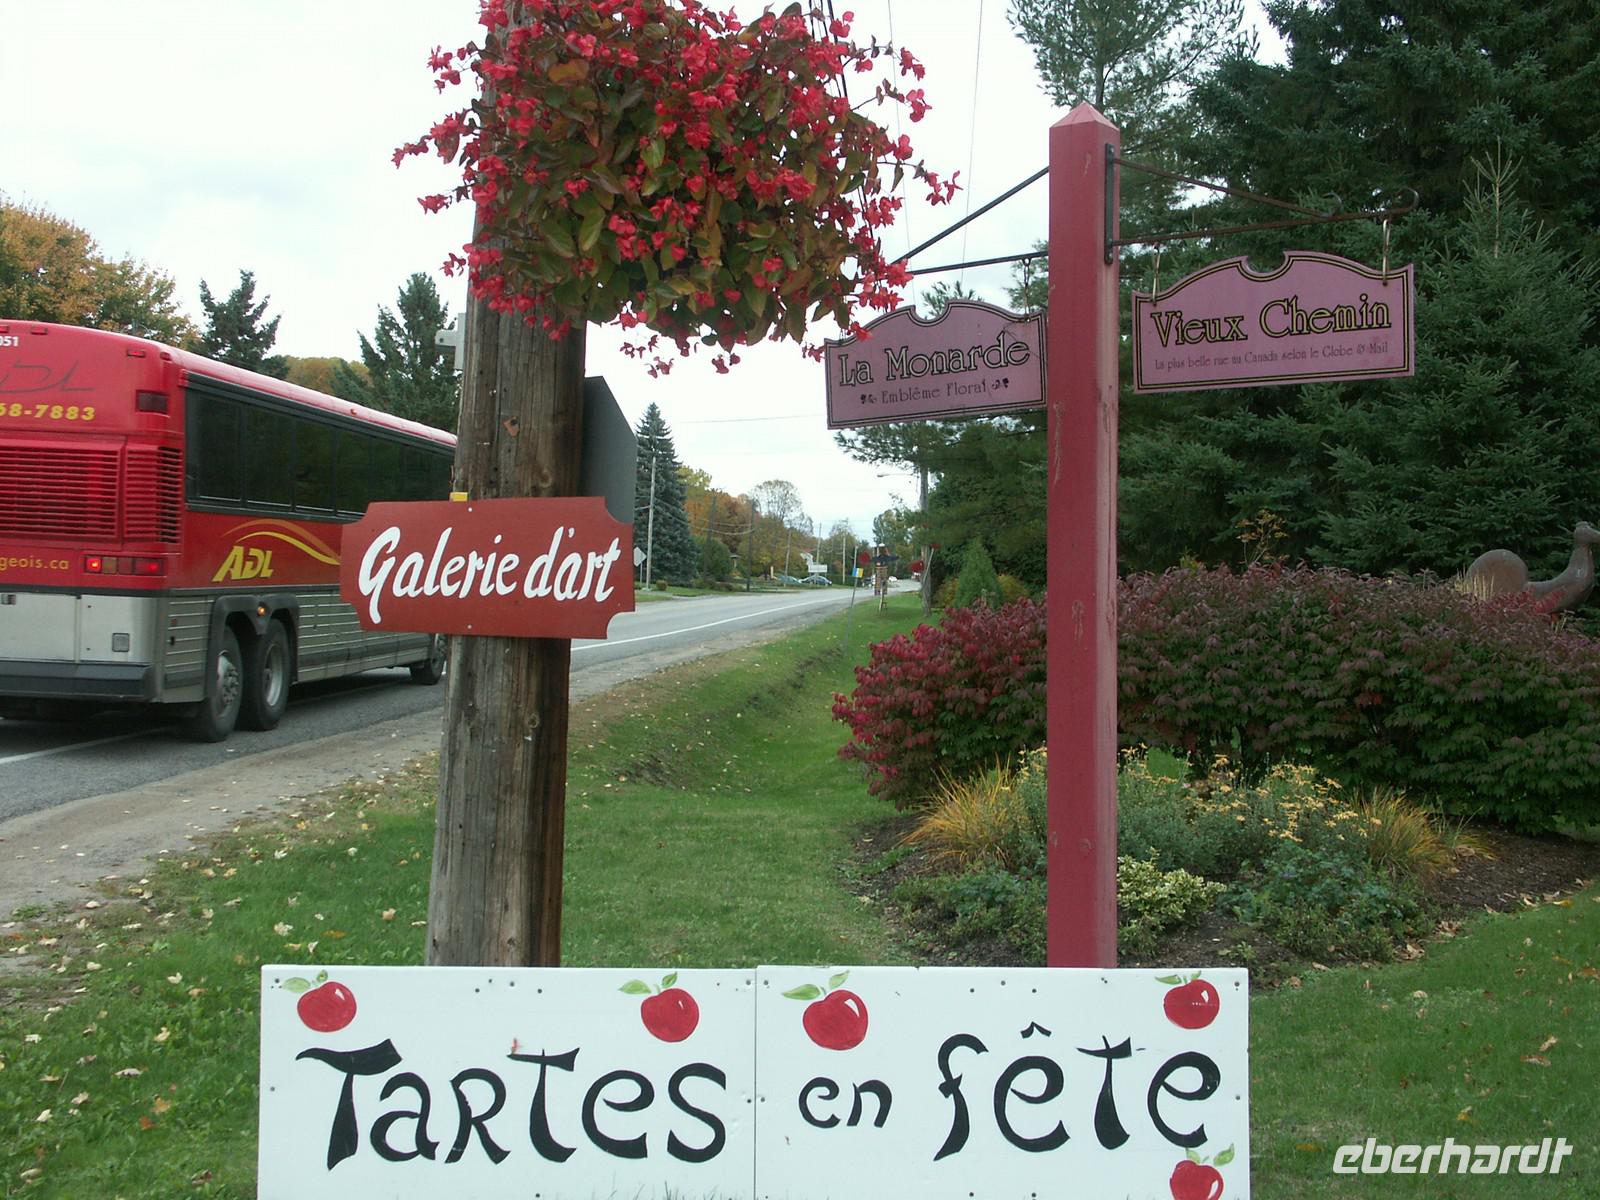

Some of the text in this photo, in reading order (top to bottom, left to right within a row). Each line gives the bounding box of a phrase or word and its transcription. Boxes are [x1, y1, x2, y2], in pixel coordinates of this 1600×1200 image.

[1151, 293, 1391, 347] Vieux Chemin
[838, 330, 1030, 387] La Monarde
[1168, 357, 1185, 372] plus
[1188, 355, 1211, 368] belle
[1214, 357, 1229, 366] rue
[1244, 350, 1278, 365] Canada
[1281, 347, 1307, 361] selon
[1310, 347, 1319, 359] le
[1322, 344, 1353, 358] Globe
[1369, 341, 1389, 354] Mail
[947, 378, 987, 397] Floral
[0, 555, 69, 571] geois.ca
[211, 545, 274, 583] ADL
[358, 526, 621, 625] Galerie d'art
[798, 1076, 893, 1128] en
[933, 1021, 1222, 1161] fête
